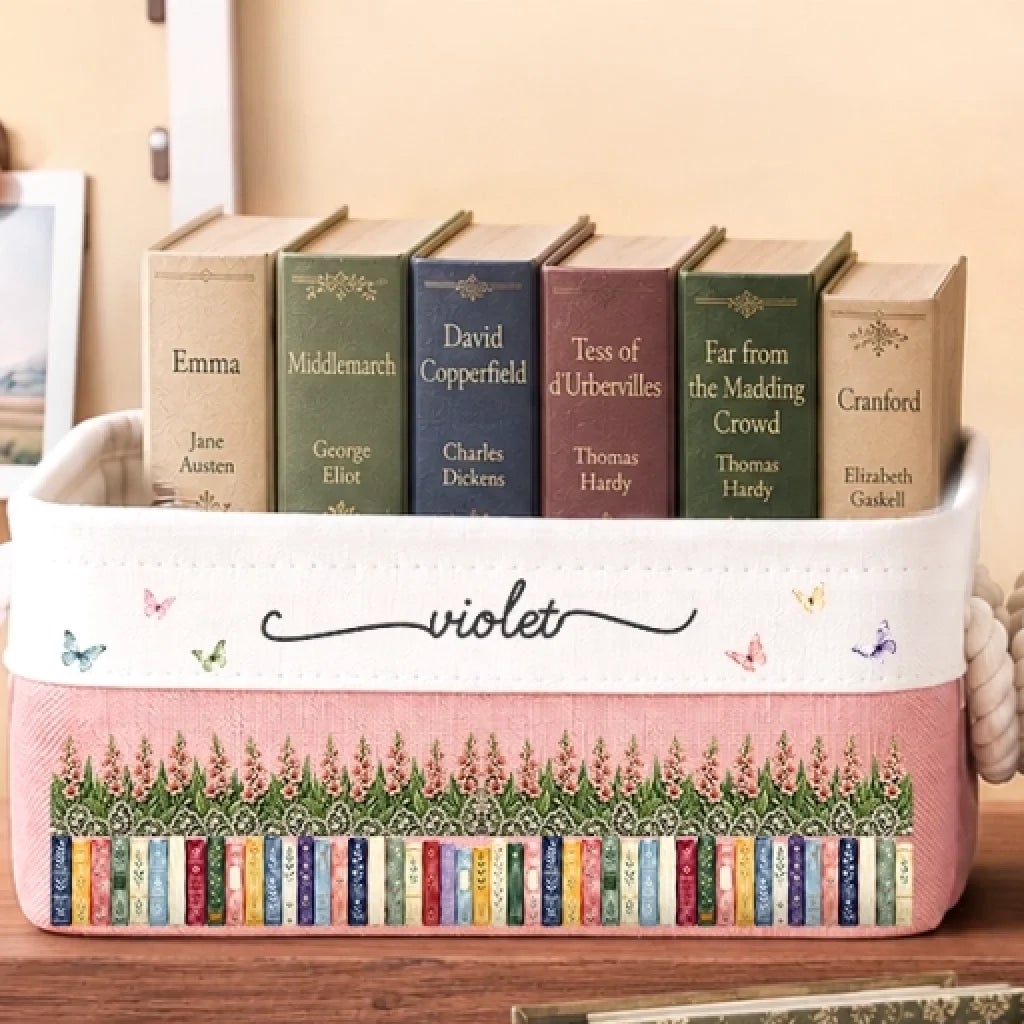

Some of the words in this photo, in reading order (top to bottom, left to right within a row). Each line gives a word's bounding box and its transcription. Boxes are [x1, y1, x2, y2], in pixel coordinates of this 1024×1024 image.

[443, 323, 503, 349] David
[571, 337, 613, 362] Tess
[618, 337, 642, 363] of
[705, 340, 737, 365] Far
[742, 340, 789, 366] from
[172, 349, 240, 375] Emma
[288, 352, 396, 376] Middlemarch
[420, 359, 528, 390] Copperfield
[549, 371, 662, 398] d'Urbervilles
[689, 374, 718, 399] the
[723, 374, 805, 406] Madding
[838, 387, 920, 412] Cranford
[713, 409, 781, 435] Crowd
[190, 431, 224, 452] Jane
[313, 440, 371, 464] George
[442, 441, 504, 462] Charles
[179, 457, 235, 474] Austen
[573, 446, 639, 467] Thomas
[715, 453, 779, 473] Thomas
[323, 466, 361, 485] Eliot
[442, 467, 505, 487] Dickens
[580, 473, 632, 496] Hardy
[844, 466, 912, 486] Elizabeth
[723, 480, 774, 502] Hardy
[850, 490, 905, 509] Gaskell
